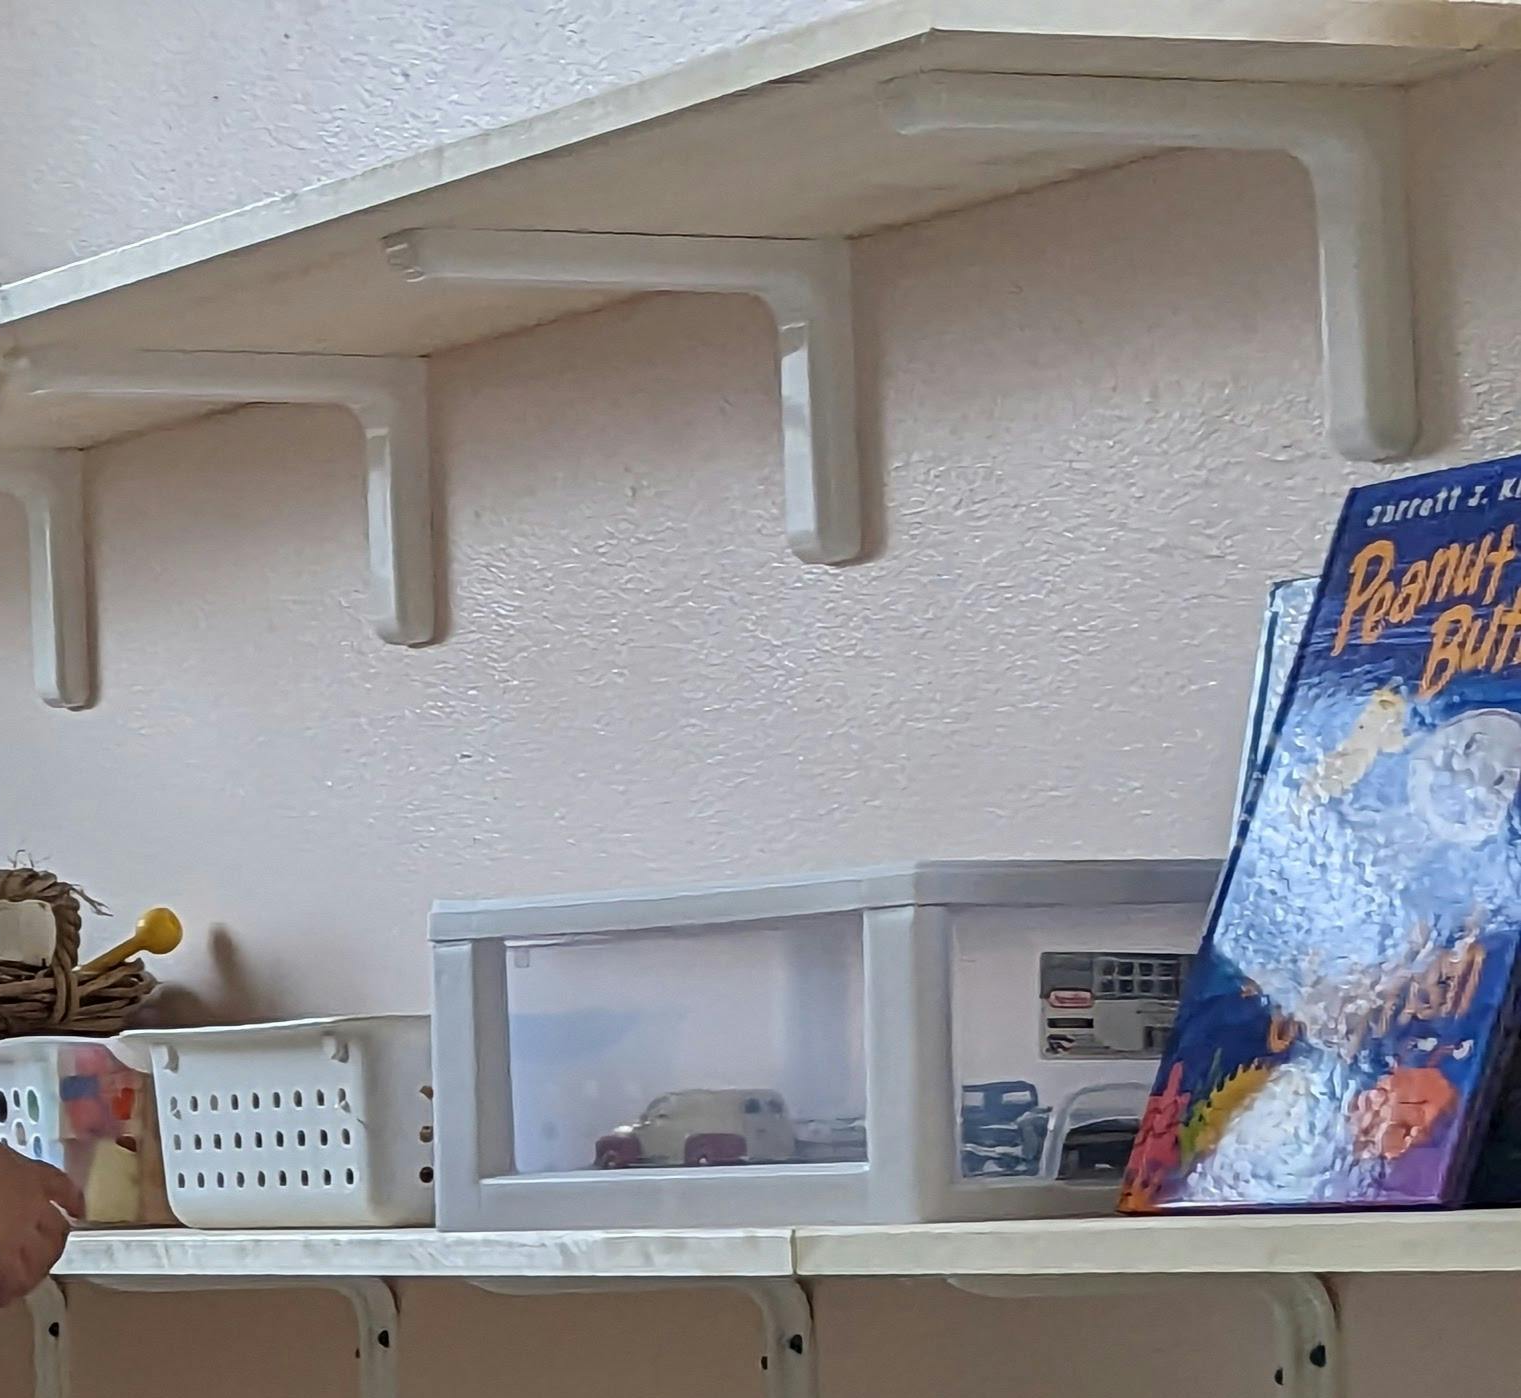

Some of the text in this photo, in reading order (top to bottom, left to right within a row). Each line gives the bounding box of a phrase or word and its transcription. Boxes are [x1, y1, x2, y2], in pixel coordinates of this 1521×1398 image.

[1467, 485, 1489, 507] J.
[1330, 523, 1517, 657] Peanut
[1418, 585, 1521, 700] But
